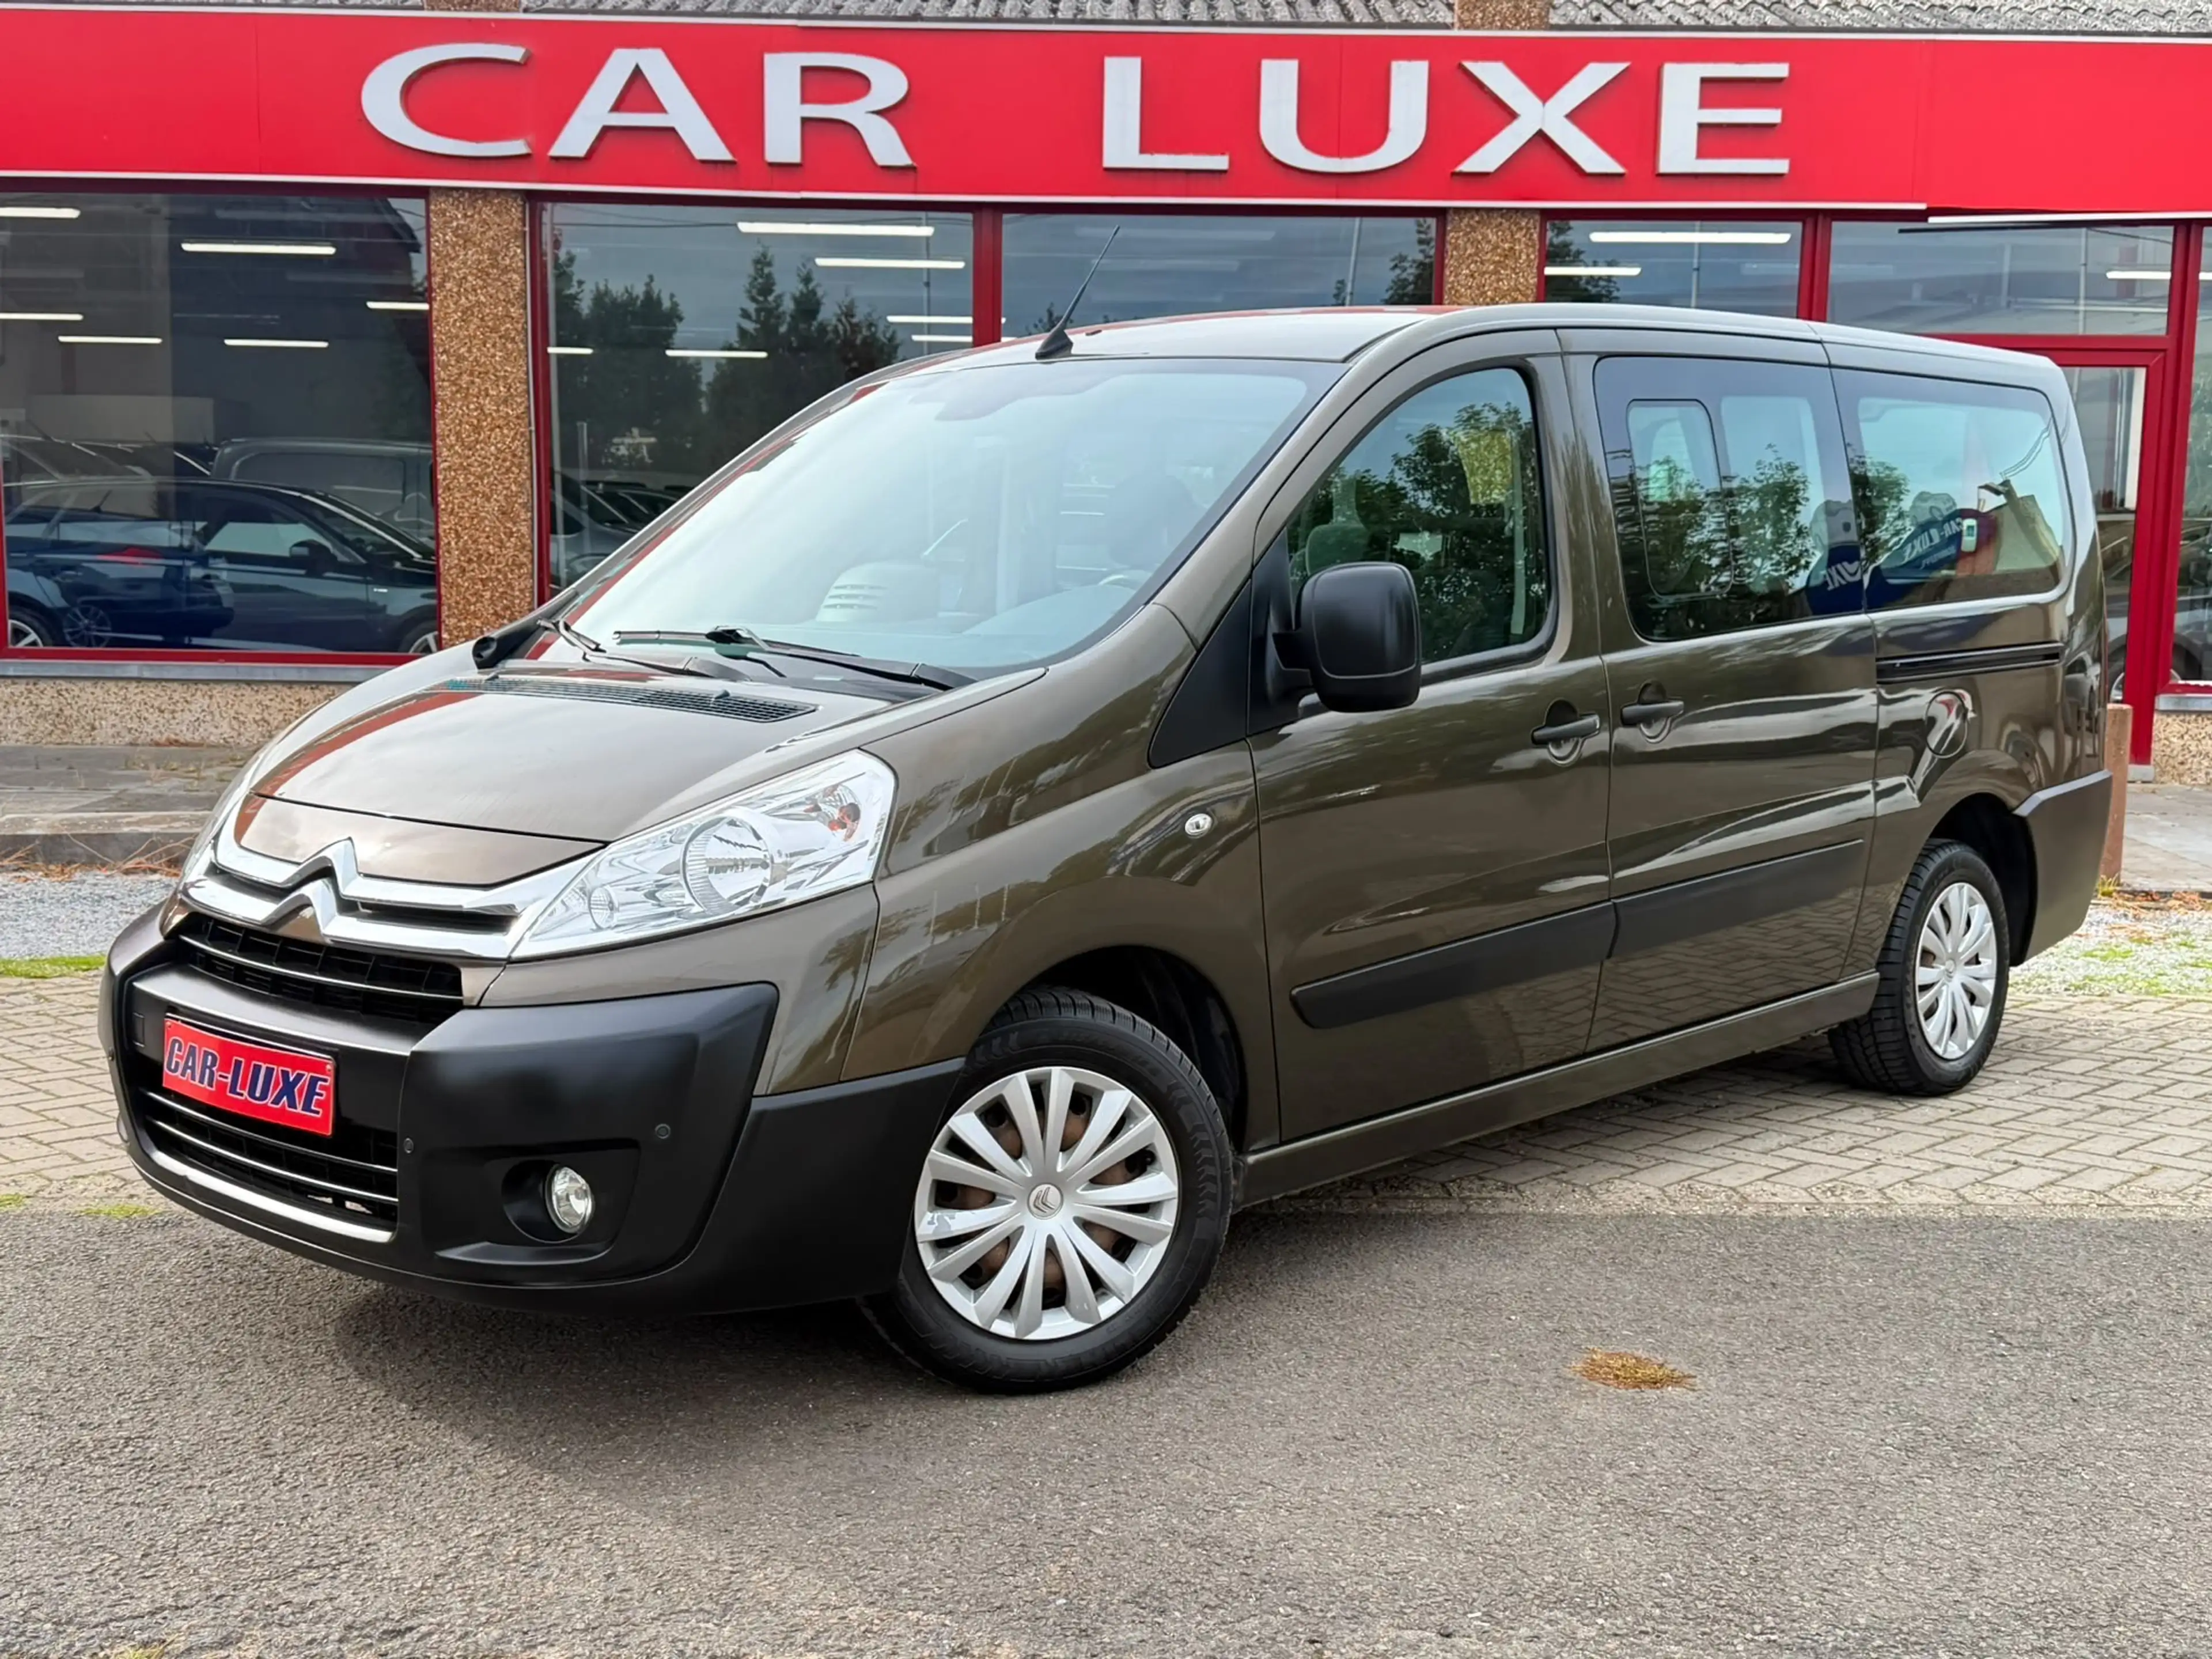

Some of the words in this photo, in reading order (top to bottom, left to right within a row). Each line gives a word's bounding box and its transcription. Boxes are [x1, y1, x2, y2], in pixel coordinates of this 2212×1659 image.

[361, 43, 916, 167] CAR
[1103, 56, 1790, 176] LUXE
[165, 1036, 329, 1117] CAR-LUXE
